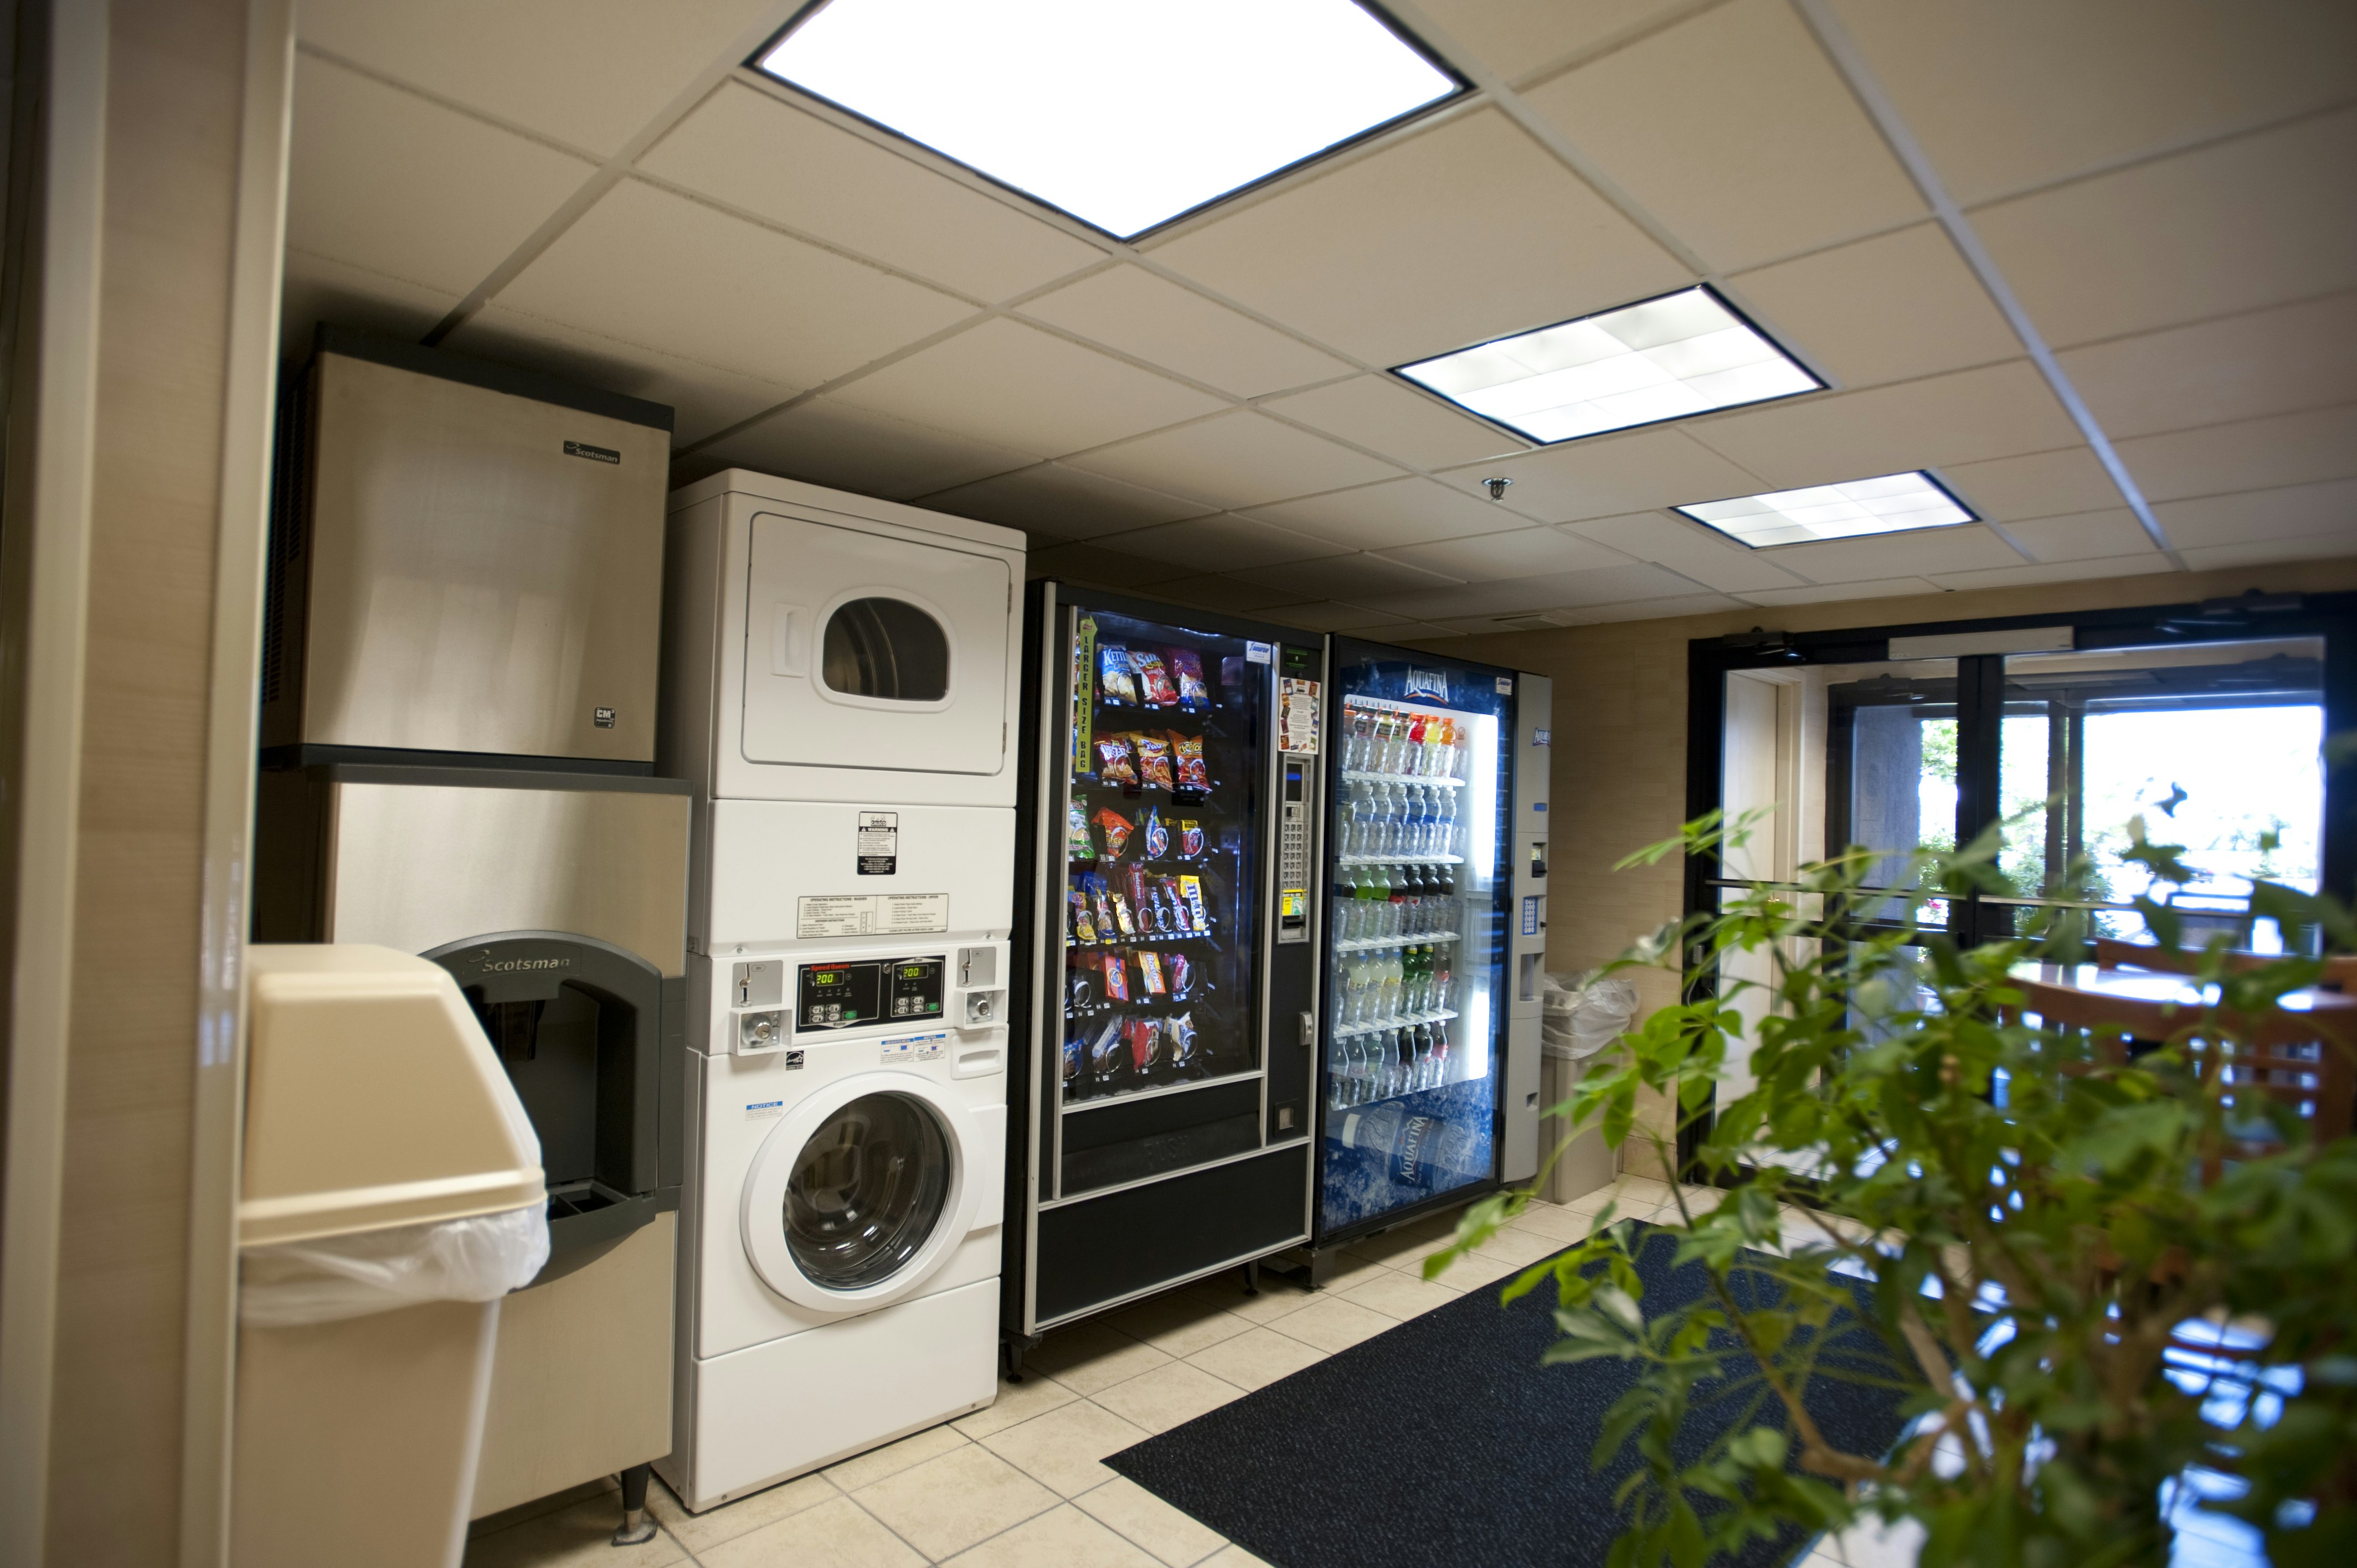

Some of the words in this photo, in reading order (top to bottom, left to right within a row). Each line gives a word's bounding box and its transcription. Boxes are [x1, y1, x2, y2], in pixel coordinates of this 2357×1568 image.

[575, 448, 617, 462] Scotsman
[1102, 648, 1128, 666] KETTL
[1404, 664, 1449, 703] AQUAFINA
[482, 958, 570, 972] Scotsman
[1145, 954, 1162, 989] Bounce
[1400, 1116, 1429, 1182] AQUAFINA
